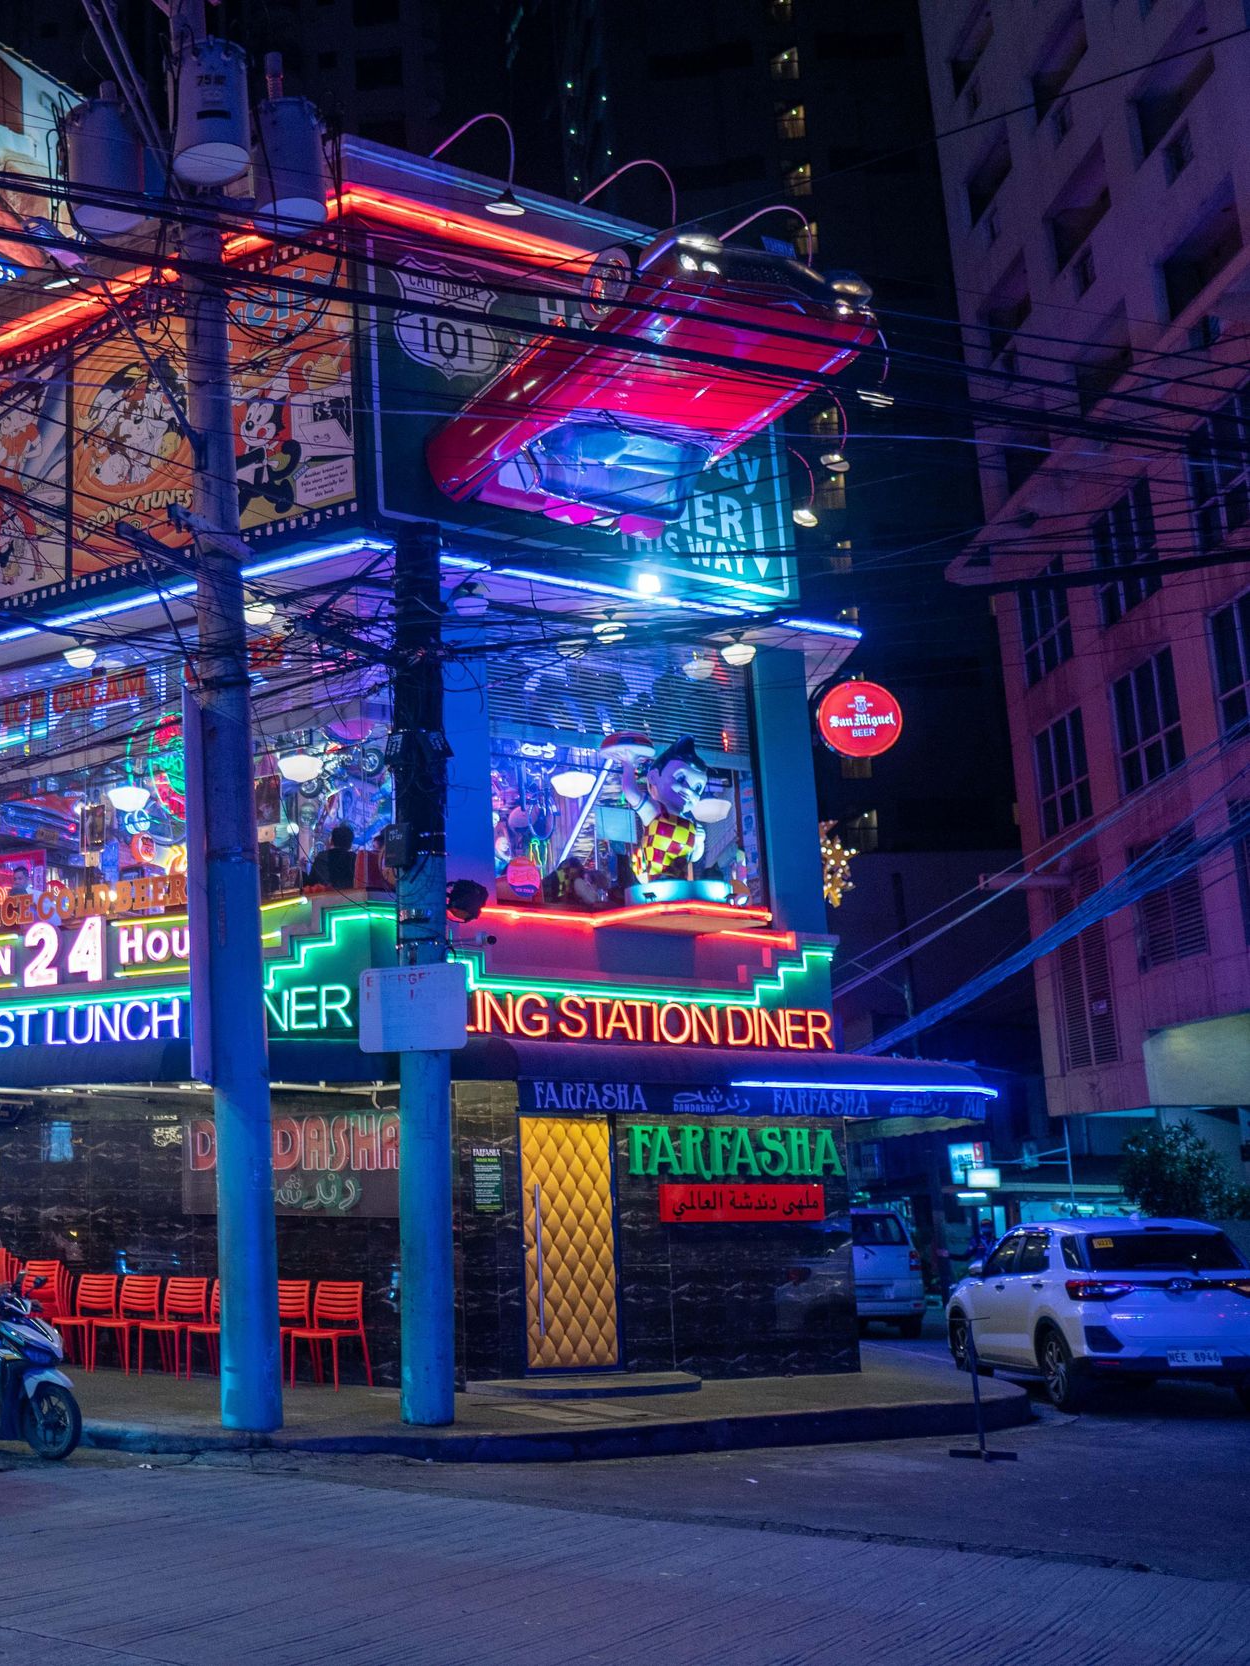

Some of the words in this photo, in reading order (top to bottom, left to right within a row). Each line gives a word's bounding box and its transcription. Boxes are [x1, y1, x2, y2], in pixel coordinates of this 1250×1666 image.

[408, 274, 480, 302] CALIFORNIA
[419, 316, 475, 365] 101
[76, 495, 140, 542] LOONEY
[141, 488, 194, 512] TUNES
[686, 535, 747, 576] WAY
[1, 691, 46, 726] ICE
[52, 667, 147, 713] CREAM
[829, 715, 853, 728] San
[854, 711, 896, 727] Miguel
[852, 728, 876, 738] BEER
[36, 882, 110, 921] COLD
[115, 873, 188, 913] BEER
[23, 914, 103, 988] 24
[118, 924, 190, 965] HOU
[45, 998, 182, 1045] LUNCH
[263, 982, 354, 1034] NER
[557, 993, 721, 1046] STATION
[726, 1003, 834, 1050] DINER
[534, 1081, 648, 1112] FARFASHA
[673, 1103, 716, 1113] DANDASHA
[773, 1089, 869, 1116] FARFASHA
[188, 1113, 400, 1172] DDASHA
[628, 1124, 846, 1181] FARFASHA
